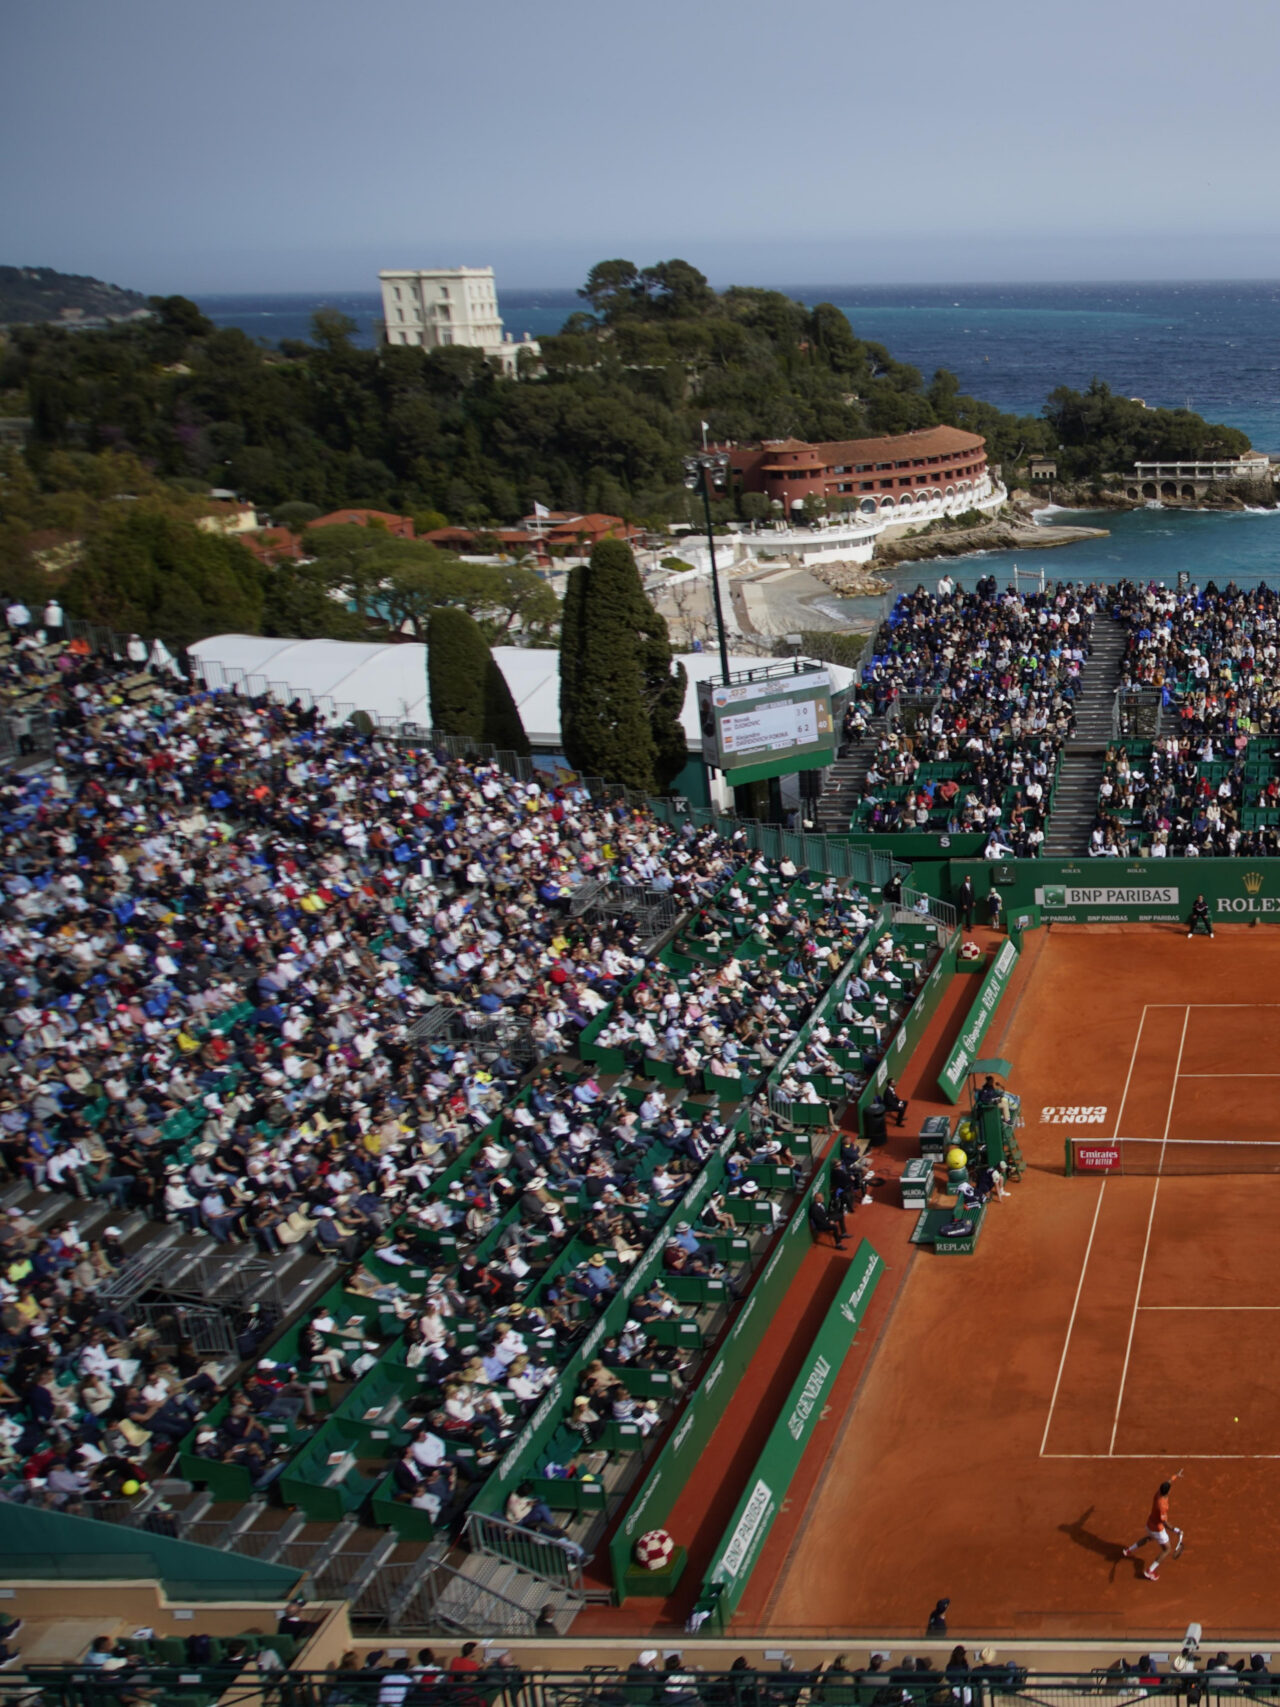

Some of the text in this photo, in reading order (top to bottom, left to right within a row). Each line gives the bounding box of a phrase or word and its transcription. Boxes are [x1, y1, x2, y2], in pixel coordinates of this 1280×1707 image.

[675, 802, 686, 812] K
[940, 837, 950, 848] S
[1071, 889, 1172, 902] BNP PARIBAS
[981, 976, 1001, 1010] REPLAY
[1041, 1106, 1107, 1115] CARLO
[1039, 1114, 1106, 1124] MONTE
[1080, 1150, 1118, 1158] Emirates
[936, 1243, 972, 1251] REPLAY
[796, 1354, 832, 1420] GENERALI
[531, 1382, 563, 1432] WELLS
[726, 1538, 743, 1570] BNP
[738, 1487, 767, 1541] PARIBAS
